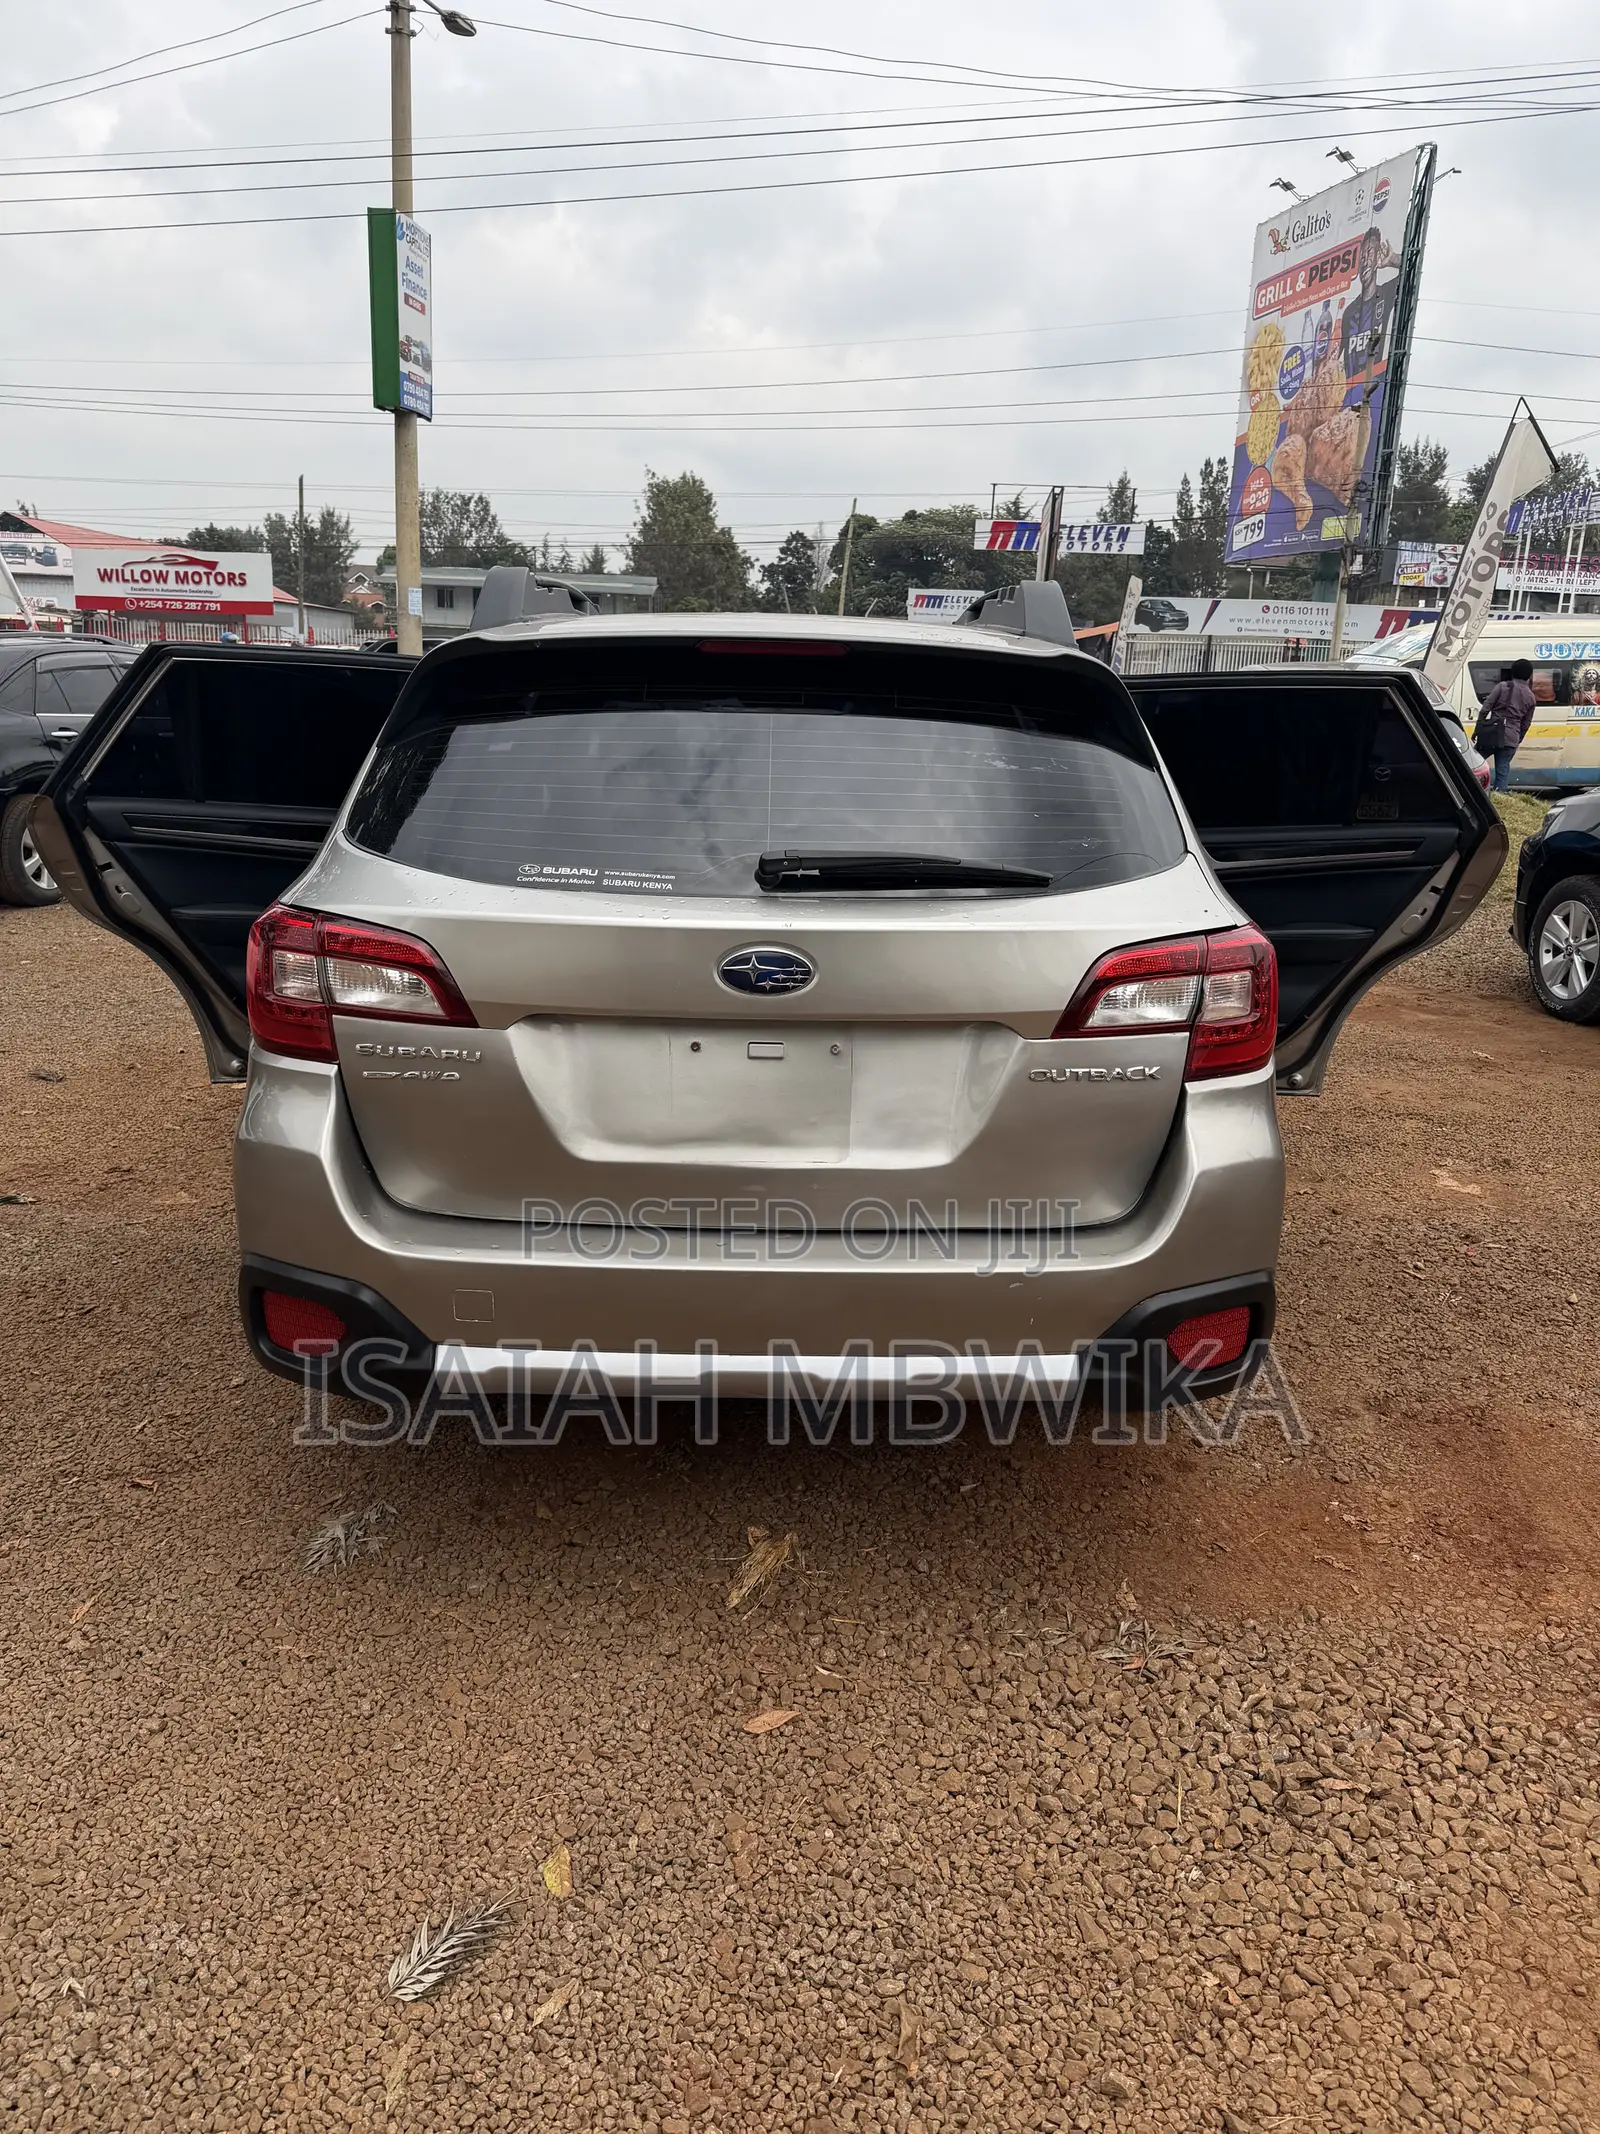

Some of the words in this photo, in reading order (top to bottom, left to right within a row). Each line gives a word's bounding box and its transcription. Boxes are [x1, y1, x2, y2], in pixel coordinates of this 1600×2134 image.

[1374, 189, 1389, 201] PEPSI
[1291, 209, 1332, 243] Galito's
[405, 256, 424, 279] Asset
[402, 272, 427, 301] Finance
[1257, 278, 1292, 309] GRILL
[1295, 270, 1306, 292] &
[1307, 246, 1358, 288] PEPSI
[1283, 350, 1301, 374] FREE
[1243, 519, 1264, 542] 799
[97, 568, 169, 585] WILLOW
[174, 570, 247, 587] MOTORS
[138, 600, 163, 609] +254
[166, 601, 183, 610] 726
[184, 603, 202, 611] 287
[204, 603, 221, 612] 791
[1273, 606, 1295, 614] 0116
[1298, 606, 1313, 615] 101
[1316, 607, 1329, 616] 111
[1574, 706, 1596, 717] KAKA
[542, 866, 598, 876] SUBARU
[602, 878, 640, 888] SUBARU
[643, 881, 673, 890] KENYA
[355, 1043, 481, 1062] SUBARU
[1029, 1066, 1162, 1083] OUTBACK
